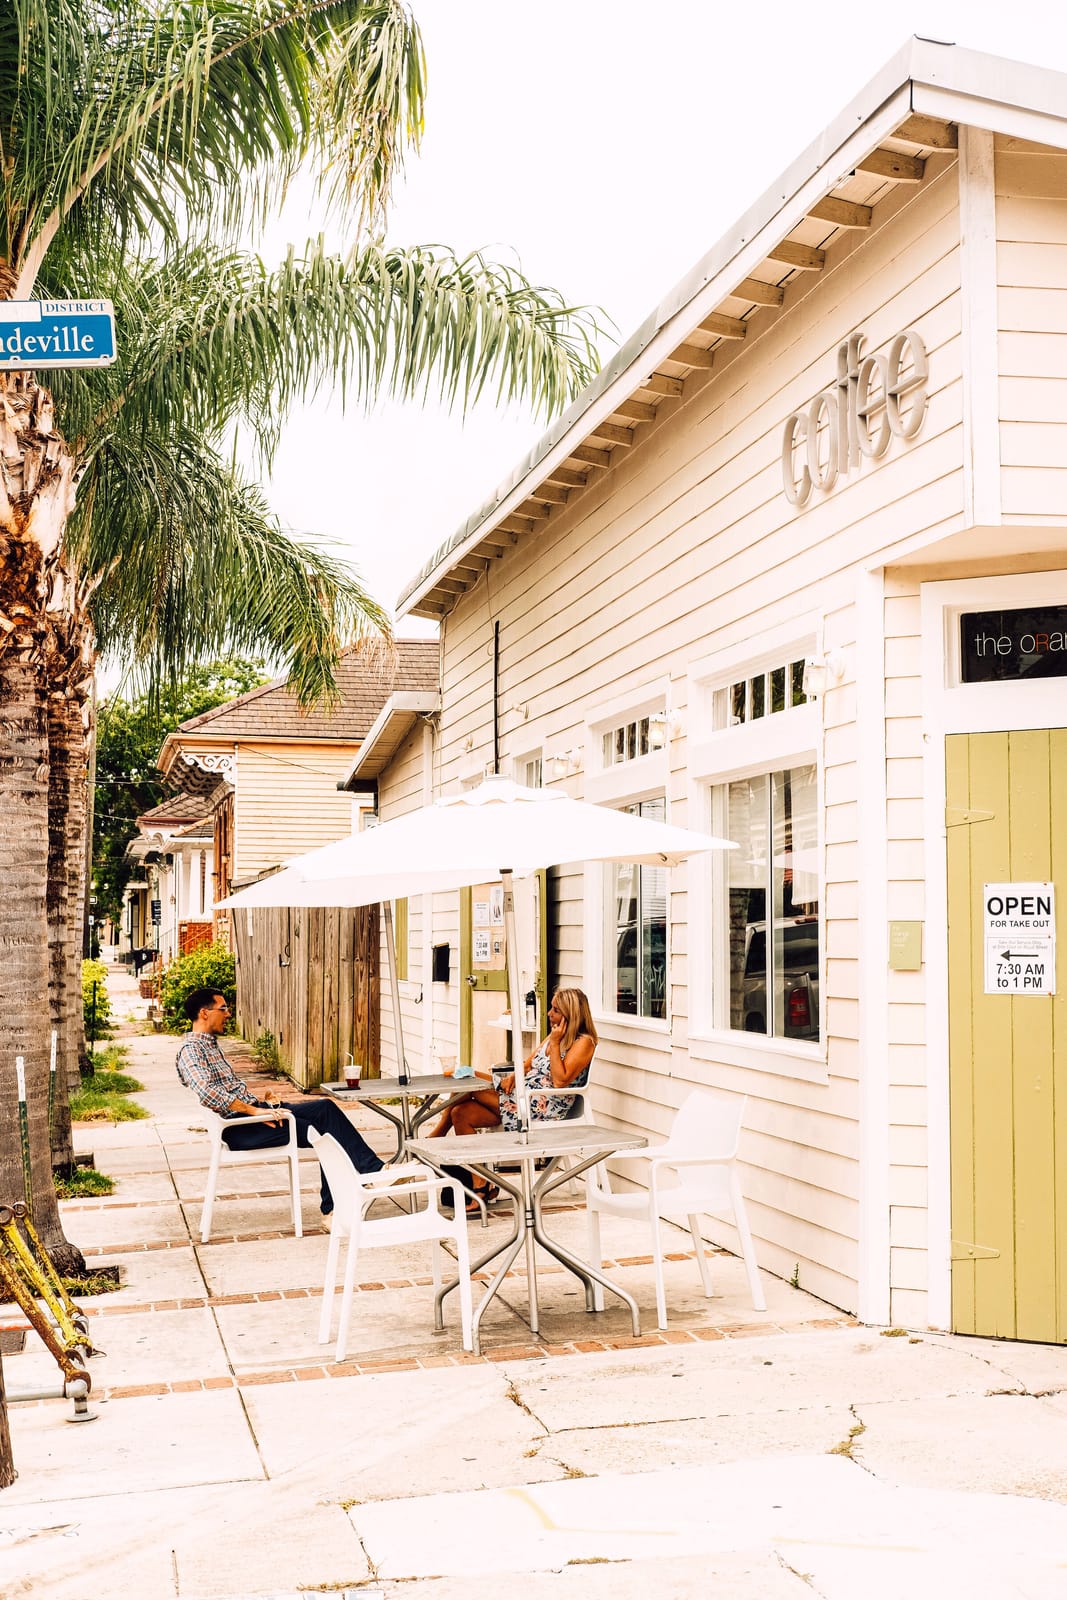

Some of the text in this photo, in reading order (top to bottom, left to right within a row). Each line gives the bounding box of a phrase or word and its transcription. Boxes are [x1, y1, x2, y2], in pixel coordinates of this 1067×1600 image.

[46, 302, 105, 312] DISTRICT
[782, 331, 929, 505] coffee
[974, 632, 1067, 656] the oRa
[987, 896, 1051, 916] OPEN
[990, 920, 1050, 928] FOR TAKE OUT
[996, 964, 1044, 975] 7:30 AM
[997, 977, 1042, 988] to 1 PM
